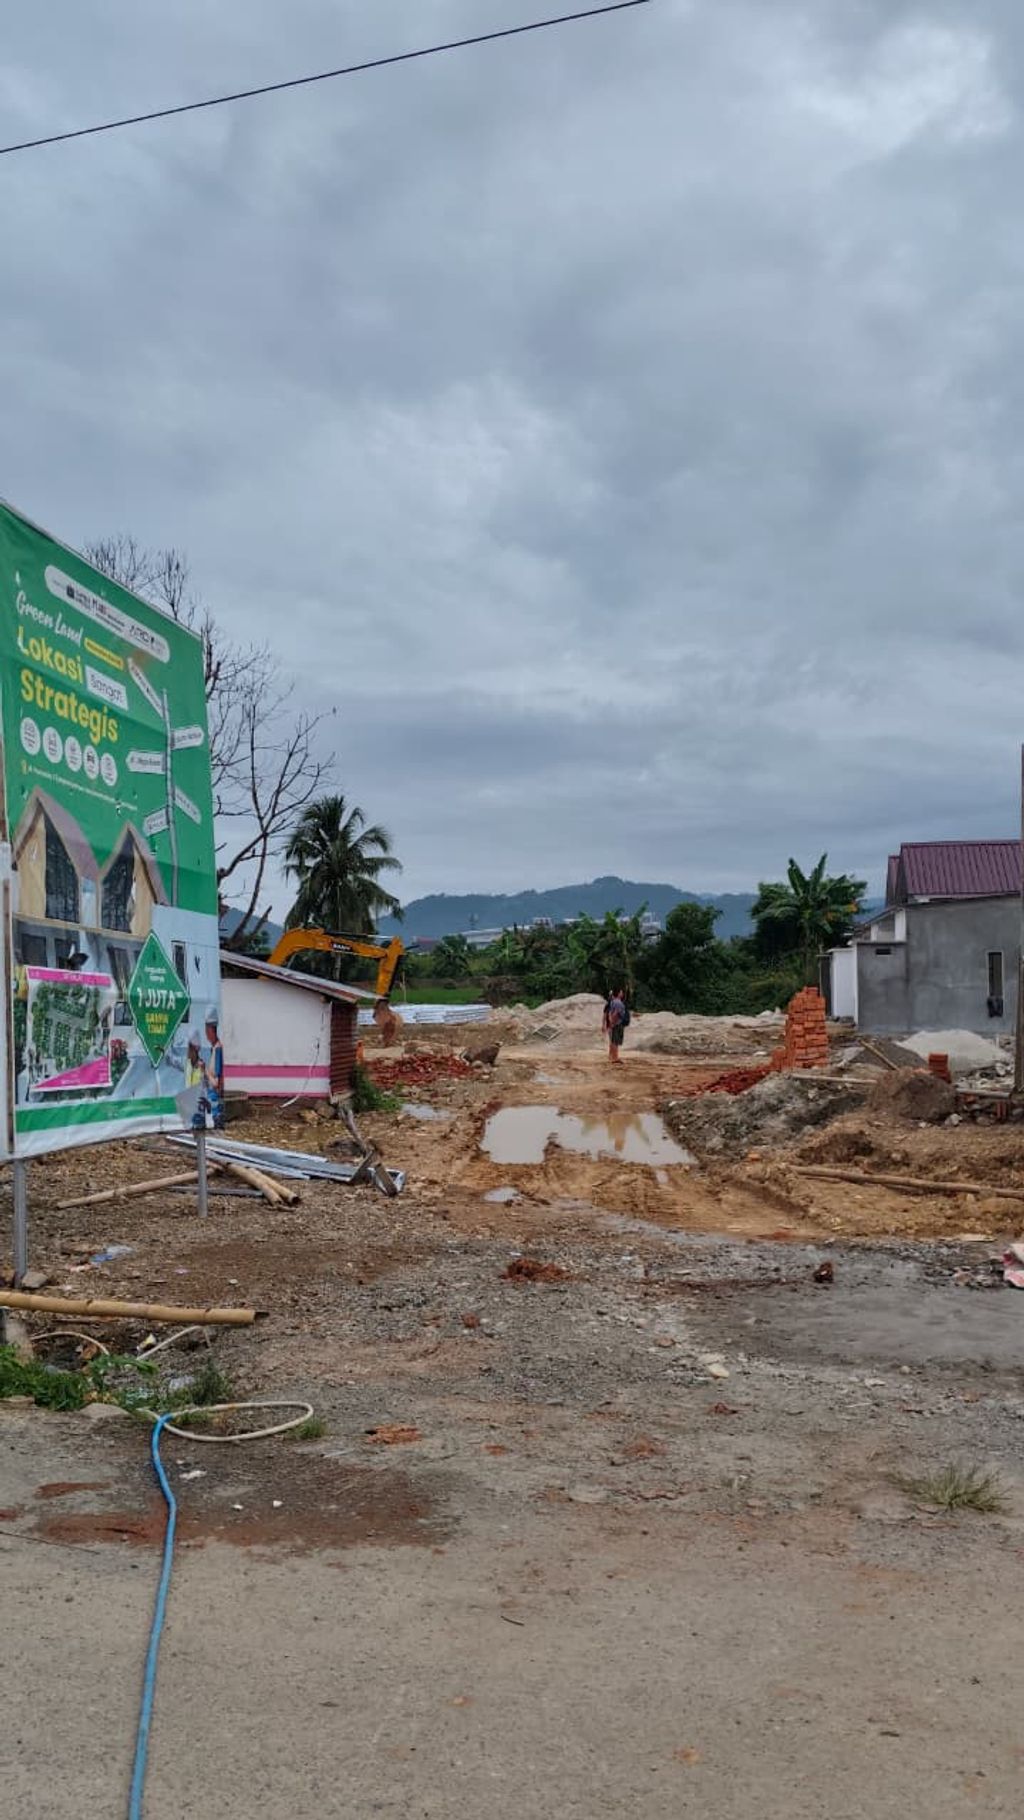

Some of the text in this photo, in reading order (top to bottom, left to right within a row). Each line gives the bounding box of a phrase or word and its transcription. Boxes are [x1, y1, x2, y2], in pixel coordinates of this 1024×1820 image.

[15, 590, 54, 629] Green
[54, 611, 84, 649] Land
[17, 626, 84, 684] Lokasi
[20, 669, 119, 746] Strategis
[136, 986, 176, 1011] 1 JUTA
